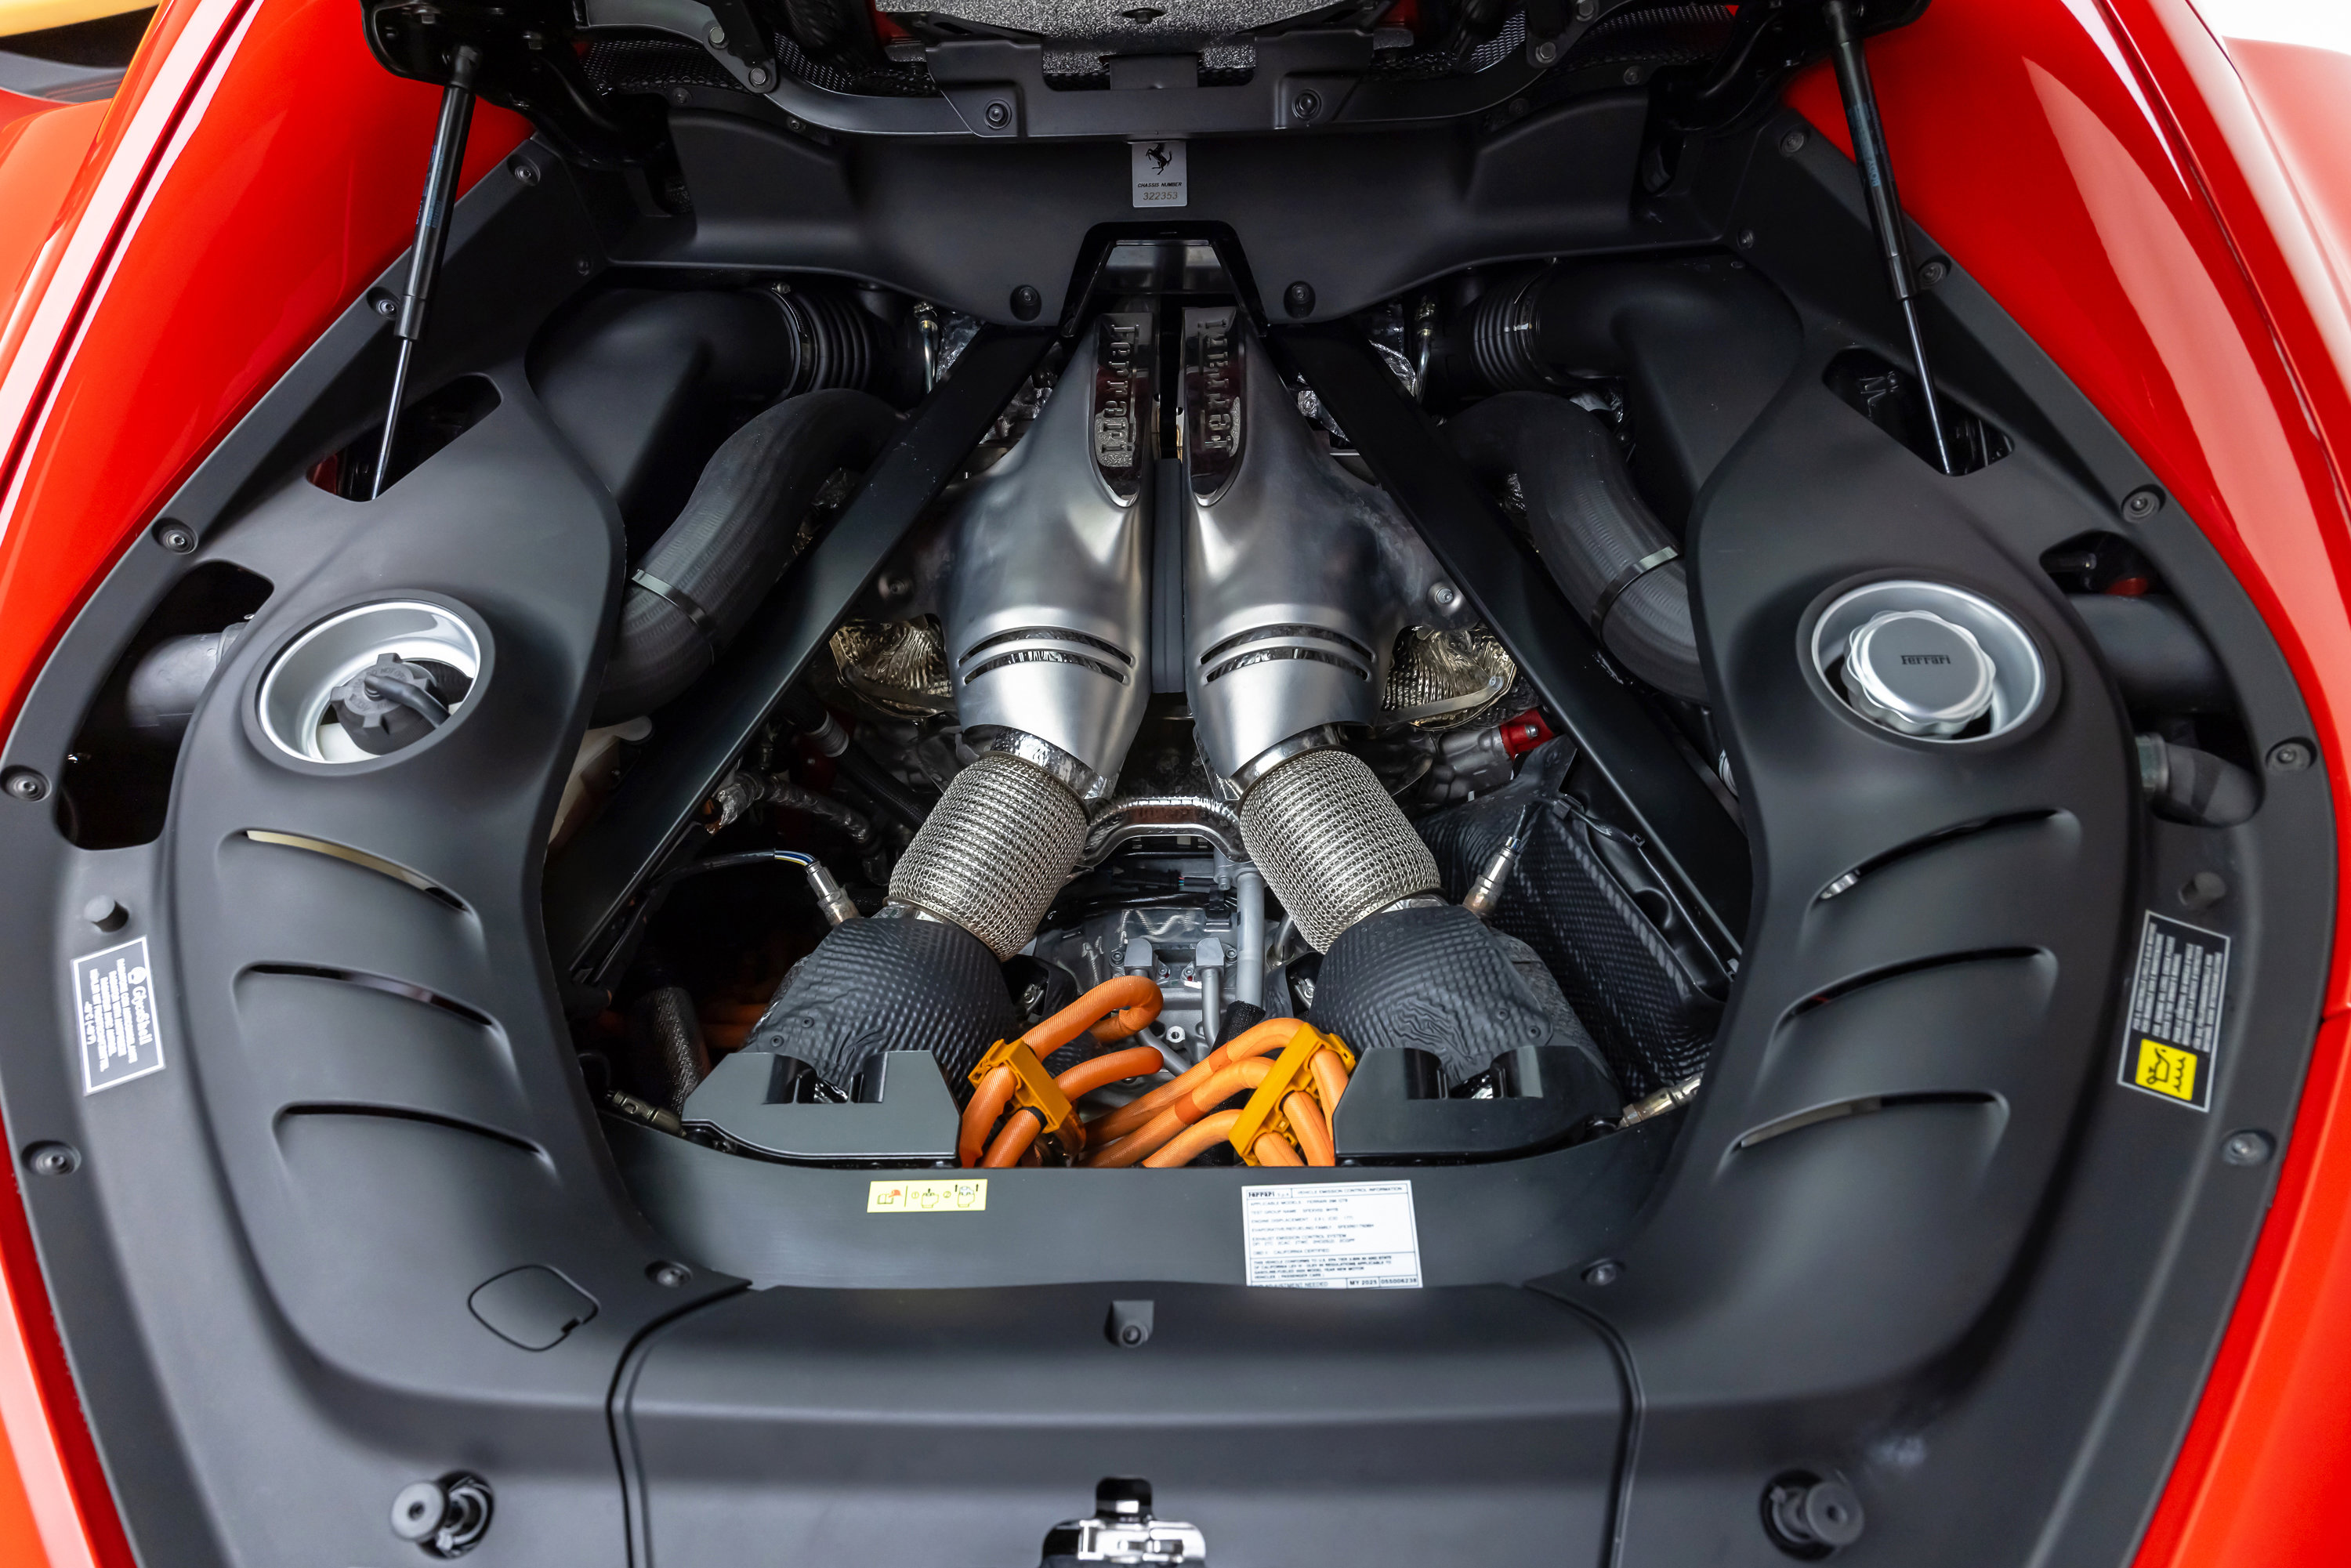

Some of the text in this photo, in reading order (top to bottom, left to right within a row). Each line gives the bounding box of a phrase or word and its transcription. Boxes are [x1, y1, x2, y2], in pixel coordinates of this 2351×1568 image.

[1143, 191, 1178, 201] 322353
[1102, 324, 1139, 453] Ferrari
[1197, 318, 1233, 451] Ferrari
[1900, 655, 1951, 664] Ferrari
[132, 986, 153, 1045] GlycoShell
